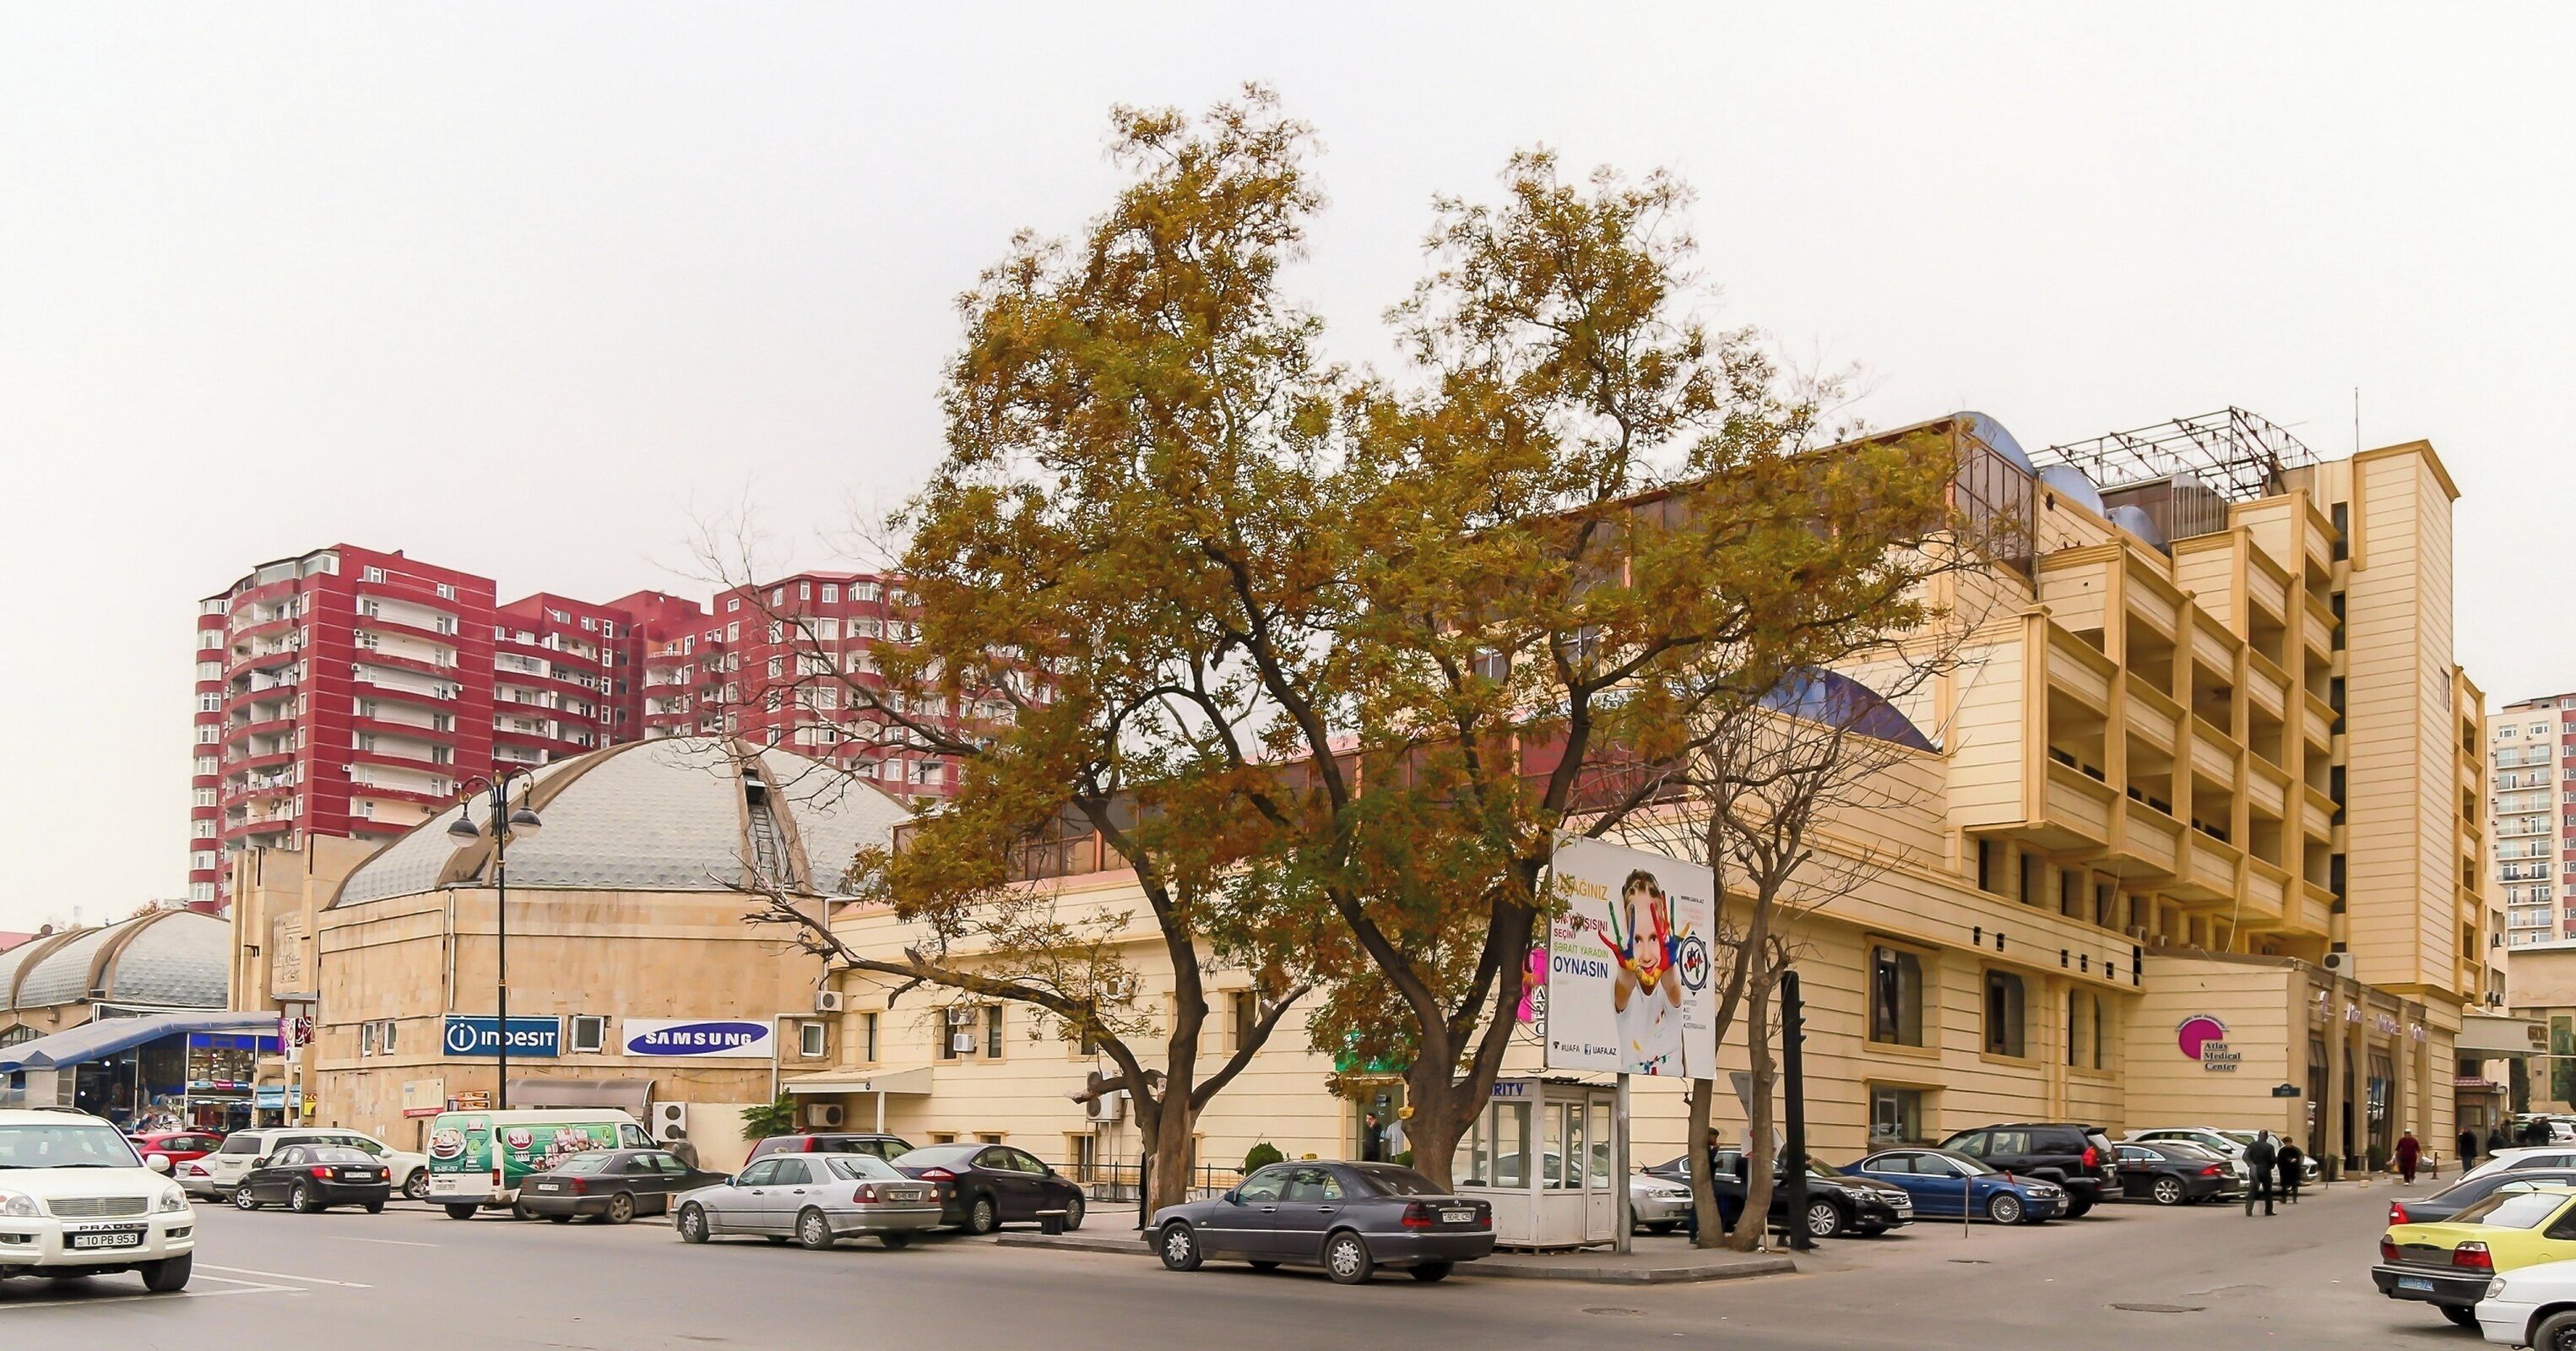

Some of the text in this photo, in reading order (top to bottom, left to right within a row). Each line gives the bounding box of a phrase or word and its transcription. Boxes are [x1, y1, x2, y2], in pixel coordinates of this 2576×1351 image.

[1580, 947, 1609, 958] YARADIN
[1554, 955, 1608, 979] OYNASIN
[644, 1032, 752, 1046] SAMSUNG
[1592, 1046, 1617, 1056] UAFA.AZ
[2205, 1051, 2242, 1061] Medical
[2205, 1062, 2237, 1071] Center
[79, 1223, 134, 1232] PRADO
[86, 1234, 136, 1246] 10 PB 953
